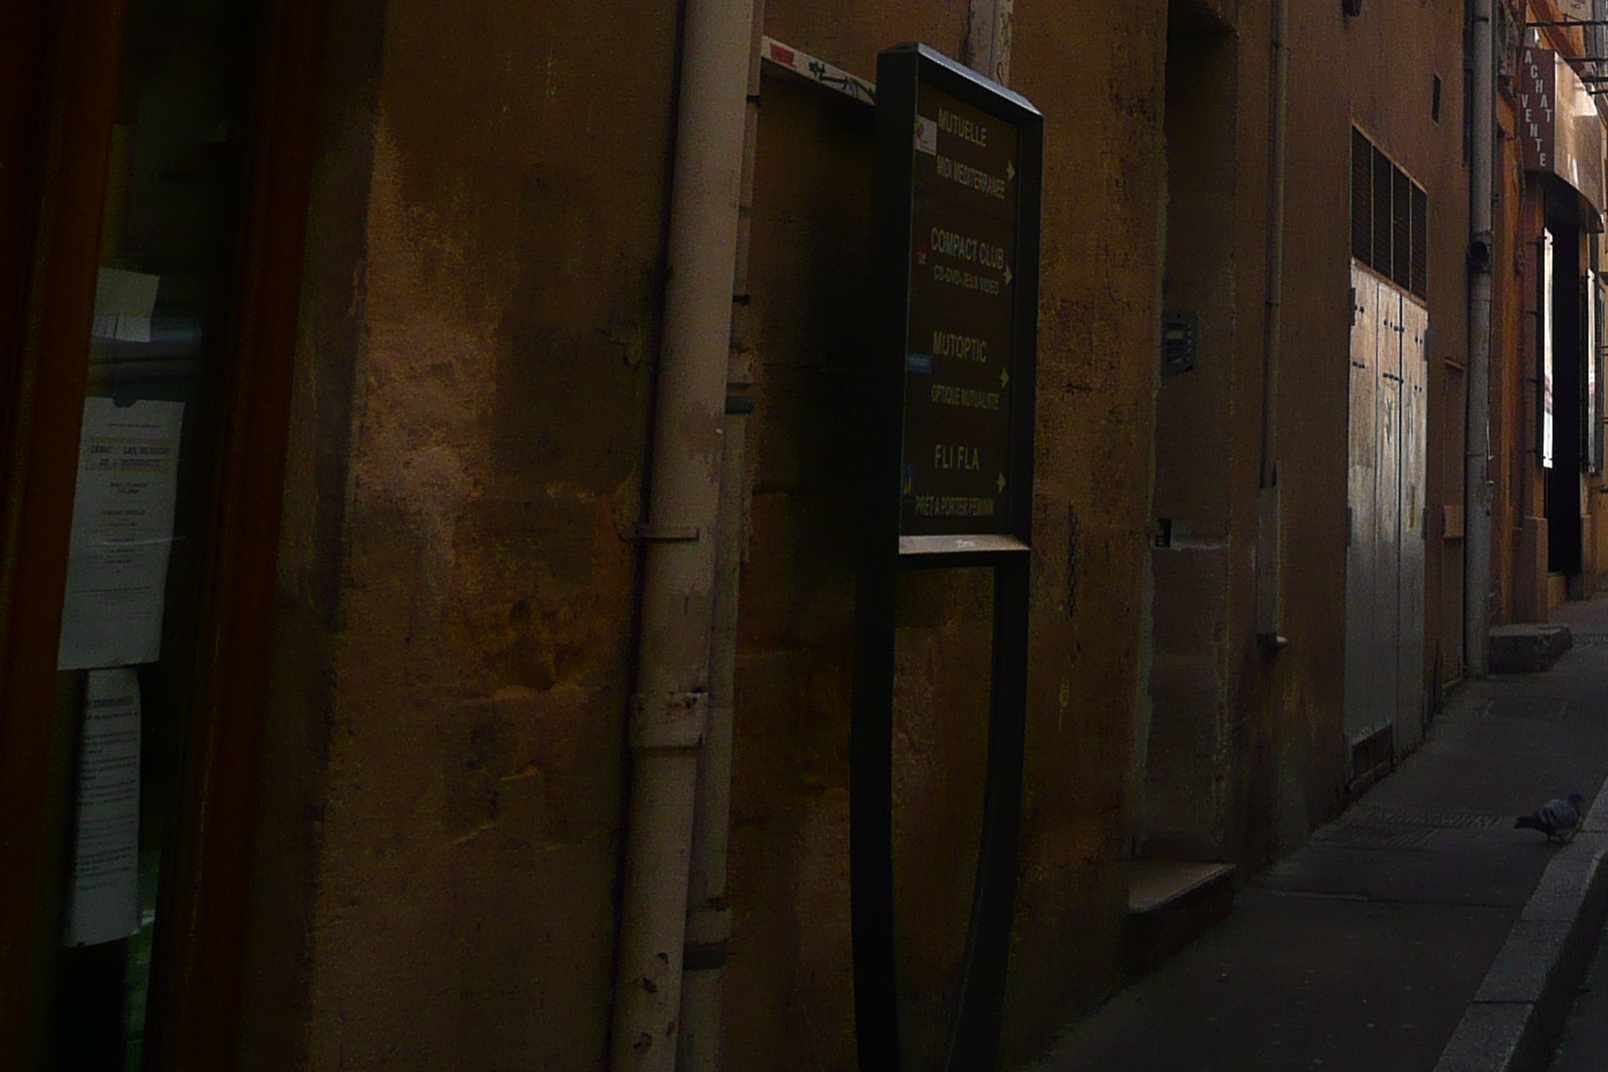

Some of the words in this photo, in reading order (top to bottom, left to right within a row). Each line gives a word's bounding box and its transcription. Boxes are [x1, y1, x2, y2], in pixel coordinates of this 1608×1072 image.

[1524, 49, 1553, 123] ACHAT
[938, 108, 987, 148] MUTUELLE
[1522, 94, 1548, 167] VENTE
[930, 227, 978, 263] COMPACT
[978, 241, 1004, 271] CLUB
[932, 330, 988, 364] MUTOPTIC
[934, 444, 954, 470] FLI
[956, 445, 980, 471] FLA
